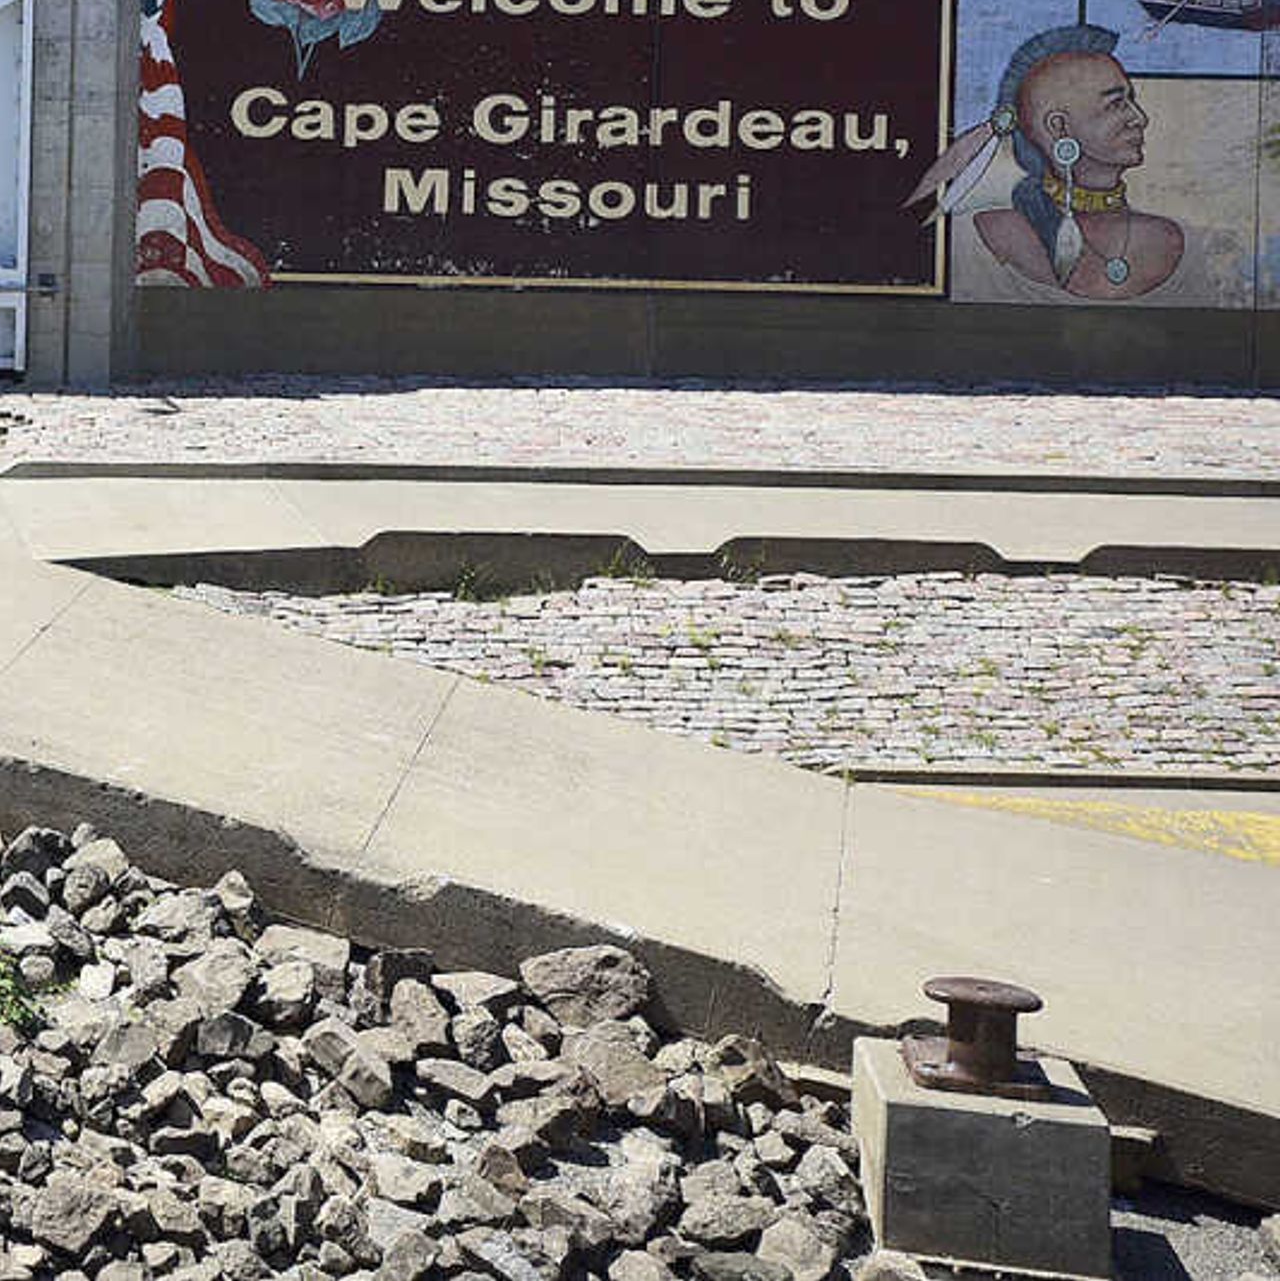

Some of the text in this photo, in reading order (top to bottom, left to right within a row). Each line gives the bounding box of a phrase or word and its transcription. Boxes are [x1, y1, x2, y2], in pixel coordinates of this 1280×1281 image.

[230, 86, 911, 158] Cape Girardeau,
[384, 168, 752, 220] Missouri
